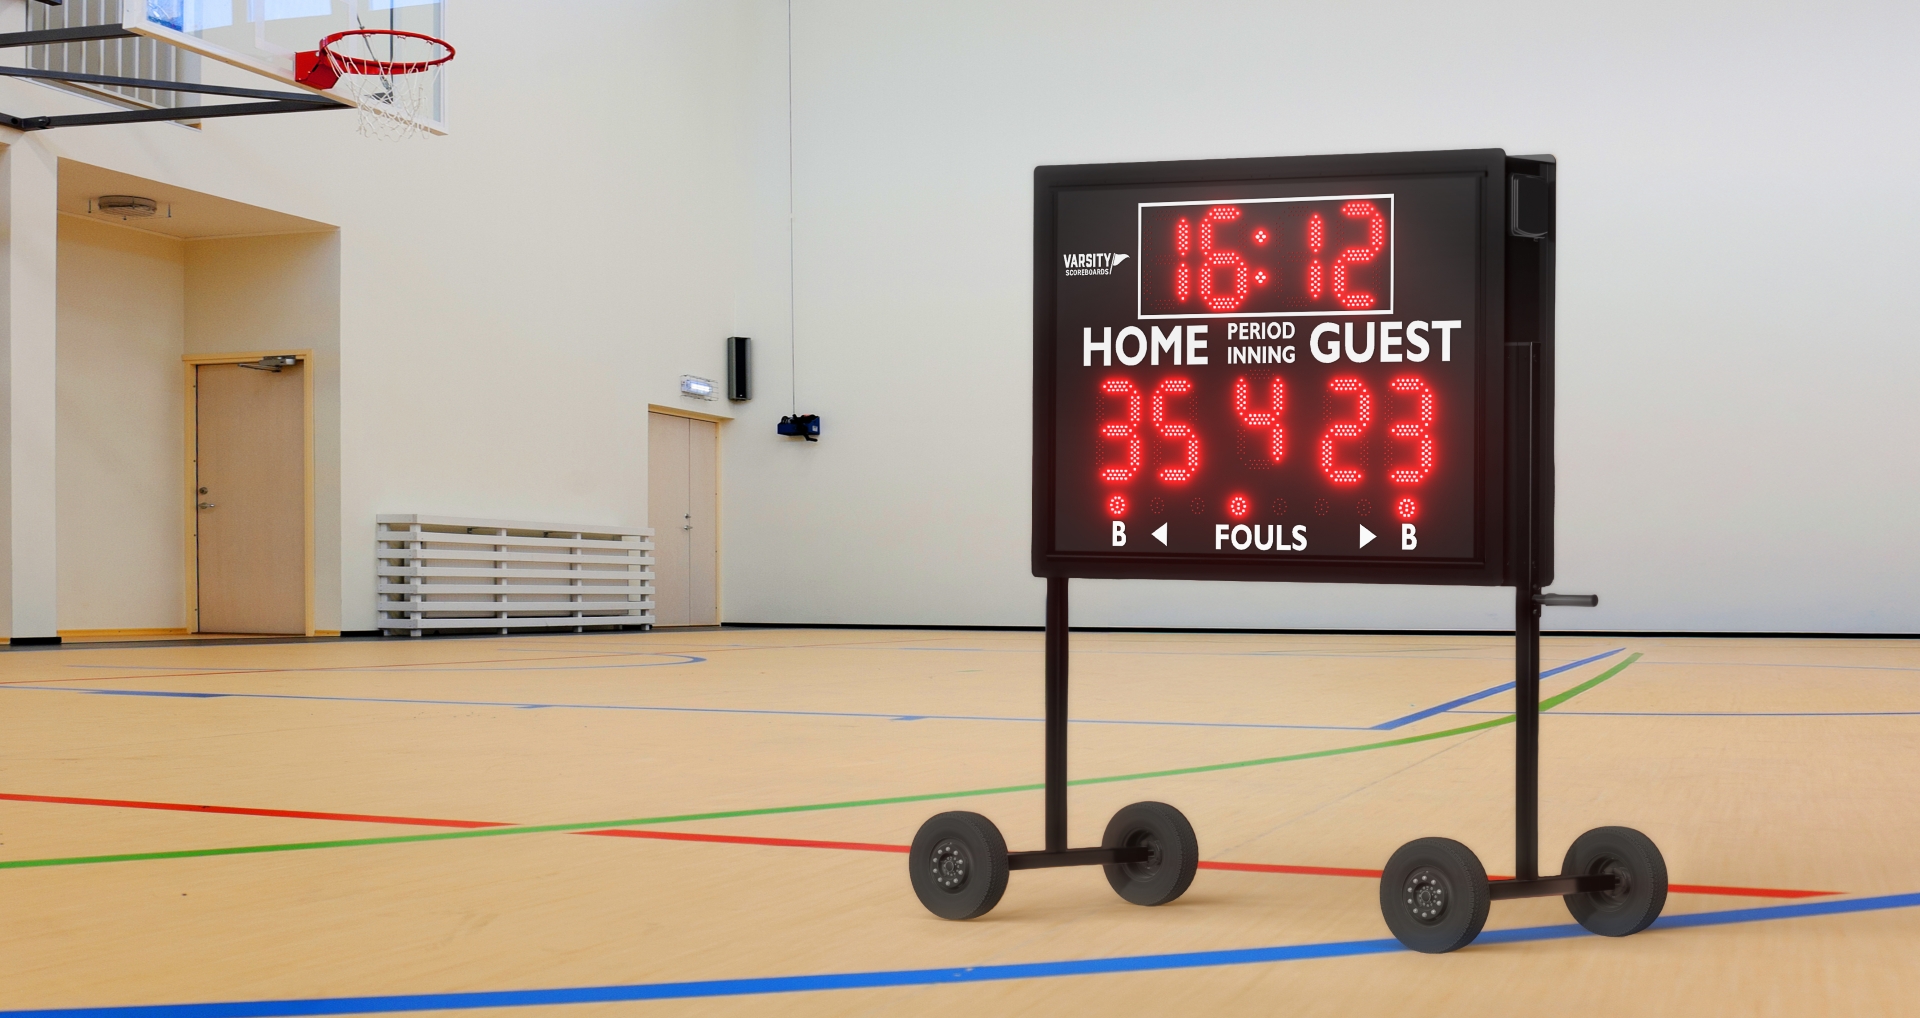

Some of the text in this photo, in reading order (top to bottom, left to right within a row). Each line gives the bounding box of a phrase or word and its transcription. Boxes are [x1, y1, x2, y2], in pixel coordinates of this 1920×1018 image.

[1063, 252, 1111, 268] VARSITY
[1176, 202, 1384, 310] 16:12
[1065, 268, 1109, 276] SCOREBOARDS
[1227, 322, 1296, 341] PERIOD
[1309, 320, 1462, 364] GUEST
[1083, 325, 1209, 367] HOME
[1227, 346, 1296, 365] INNING
[1101, 379, 1199, 481] 35
[1236, 377, 1284, 463] 4
[1321, 377, 1433, 483] 23
[1111, 520, 1127, 547] B
[1215, 524, 1308, 551] FOULS
[1402, 523, 1418, 550] B
